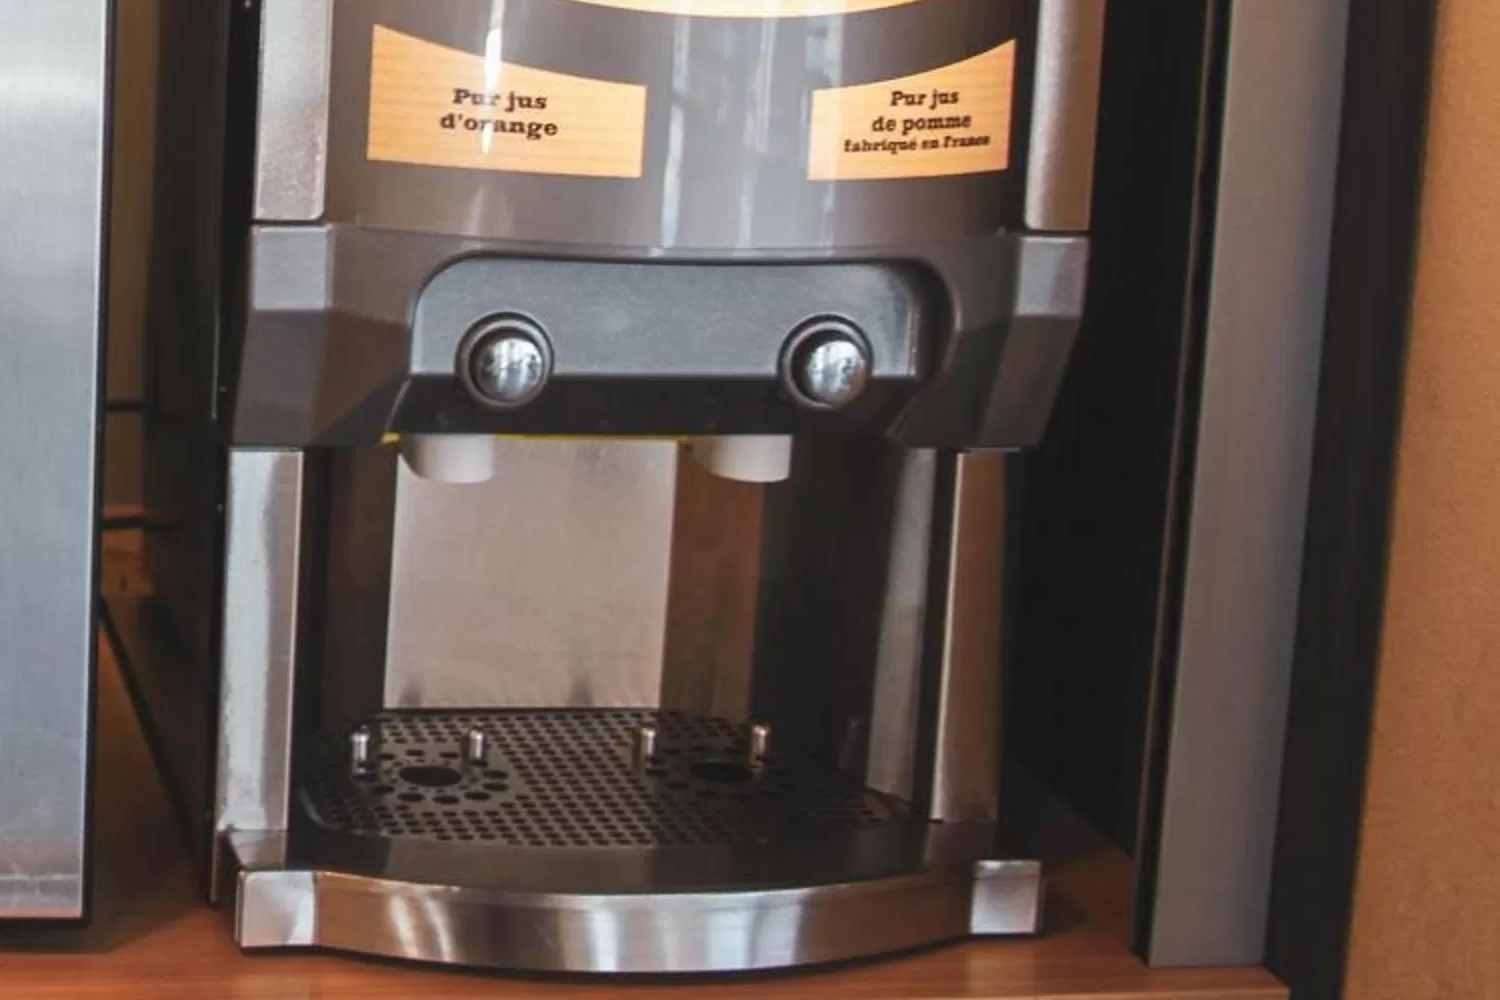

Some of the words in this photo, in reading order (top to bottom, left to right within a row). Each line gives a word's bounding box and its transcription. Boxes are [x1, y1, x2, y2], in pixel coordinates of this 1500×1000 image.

[453, 87, 501, 106] Pur
[505, 91, 548, 112] jus
[891, 91, 927, 107] Pur
[929, 88, 960, 110] jus
[439, 112, 559, 141] d'orange
[872, 115, 897, 132] de
[902, 113, 973, 136] pomme
[844, 137, 917, 155] fabriqué
[921, 139, 940, 150] en
[943, 133, 991, 149] France
